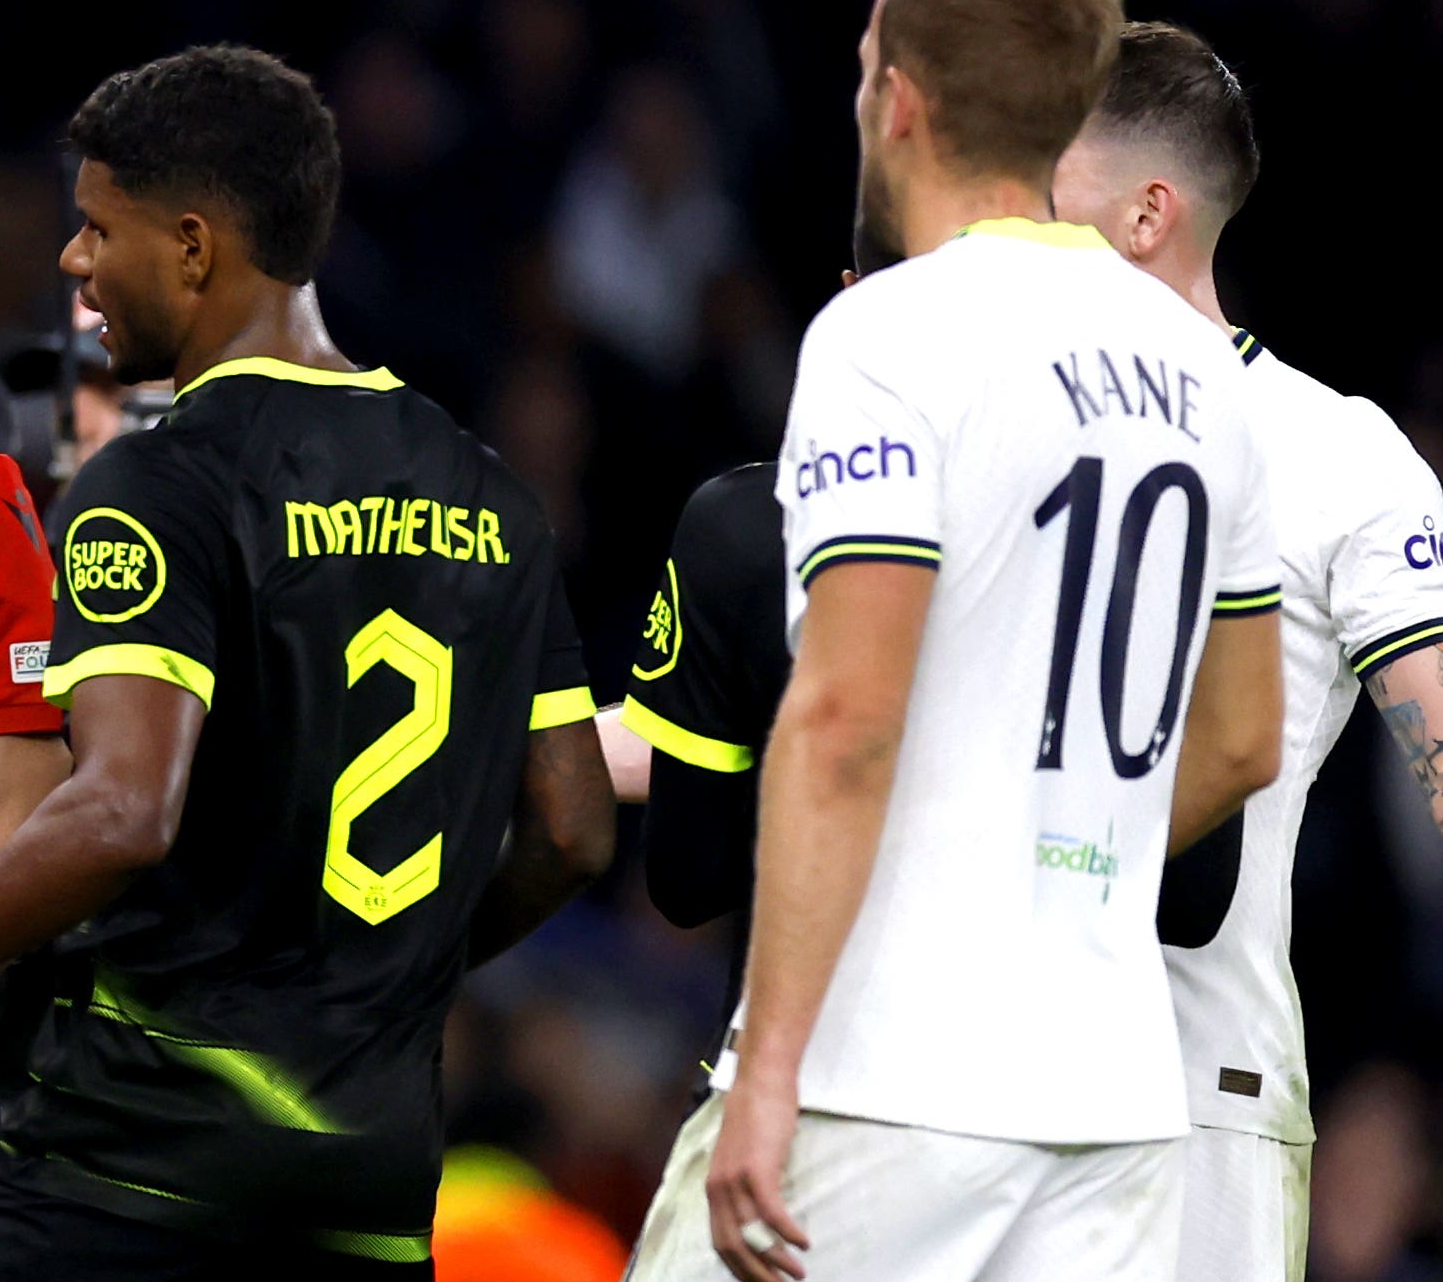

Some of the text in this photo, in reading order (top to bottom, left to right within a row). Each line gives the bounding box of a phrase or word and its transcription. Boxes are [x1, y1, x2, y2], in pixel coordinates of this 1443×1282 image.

[1052, 348, 1201, 445] KANE
[72, 541, 147, 569] SUPER
[74, 565, 144, 592] BOCK
[1034, 456, 1209, 779] 10
[322, 607, 453, 926] 2
